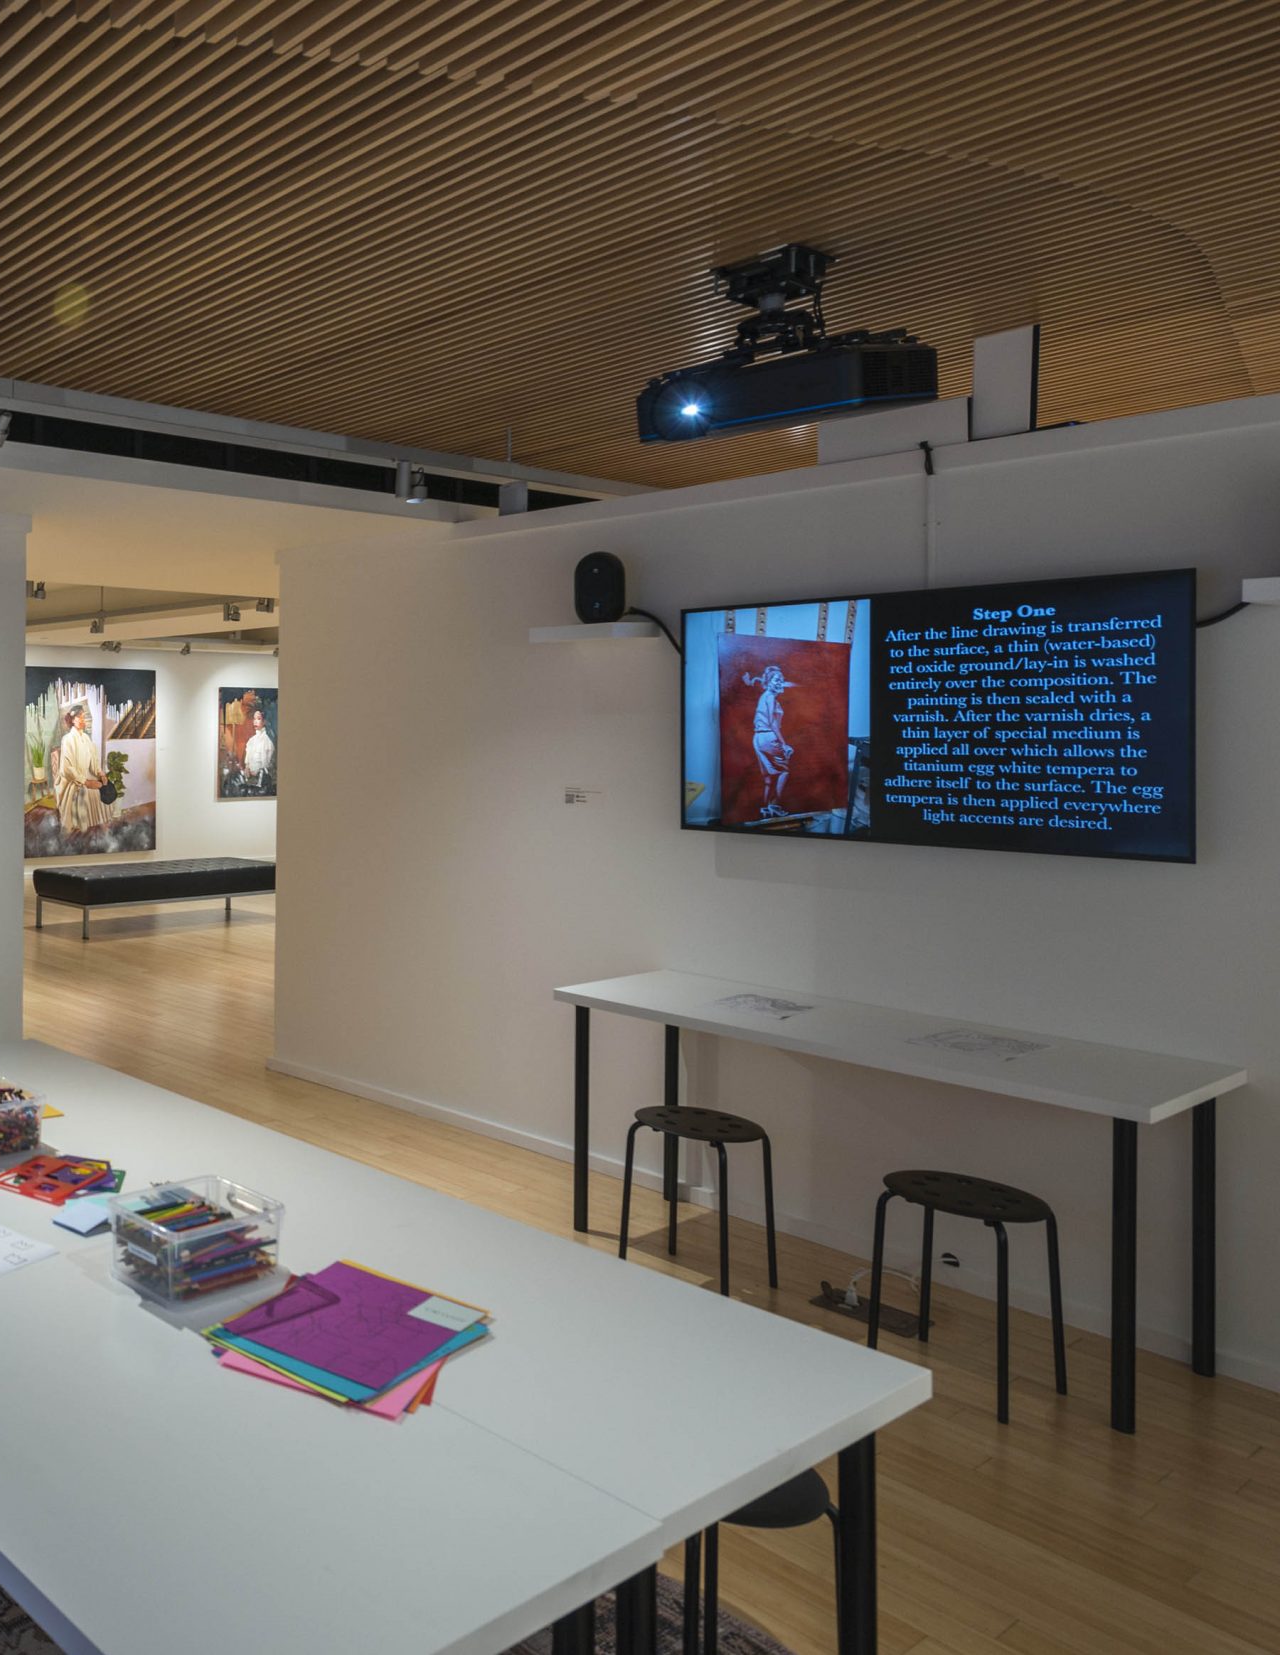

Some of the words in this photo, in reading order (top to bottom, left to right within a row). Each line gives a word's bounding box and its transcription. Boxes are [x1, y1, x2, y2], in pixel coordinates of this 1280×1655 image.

[973, 608, 1012, 622] Step
[1016, 605, 1056, 618] One
[885, 630, 921, 642] After
[924, 628, 947, 640] the
[951, 626, 978, 638] line
[982, 622, 1046, 638] drawing
[1051, 621, 1063, 633] is
[1068, 614, 1162, 632] transferred
[890, 649, 904, 658] to
[908, 645, 930, 657] the
[934, 643, 989, 656] surface,
[994, 645, 1003, 653] a
[1008, 640, 1039, 652] thin
[1044, 633, 1156, 654] (water-based)
[890, 662, 912, 674] red
[916, 660, 955, 673] oxide
[960, 656, 1068, 675] ground/lay-in
[1074, 655, 1086, 668] is
[1091, 652, 1156, 667] washed
[888, 678, 941, 692] entirely
[945, 680, 977, 688] over
[982, 676, 1005, 688] the
[1010, 673, 1114, 690] composition.
[1120, 671, 1156, 684] The
[908, 694, 967, 709] painting
[971, 693, 982, 705] is
[987, 692, 1020, 704] then
[1026, 691, 1075, 704] sealed
[1079, 690, 1116, 704] with
[1122, 694, 1132, 703] a
[893, 710, 948, 722] varnish.
[953, 710, 992, 722] After
[996, 710, 1020, 722] the
[1024, 708, 1084, 721] varnish
[1088, 708, 1135, 724] dries,
[1140, 712, 1152, 721] a
[902, 727, 929, 738] thin
[934, 727, 969, 742] layer
[973, 726, 990, 738] of
[995, 726, 1046, 742] special
[1052, 726, 1122, 739] medium
[1127, 726, 1140, 740] is
[896, 743, 948, 758] applied
[952, 744, 969, 755] all
[974, 748, 1007, 756] over
[1011, 744, 1058, 756] which
[1063, 744, 1115, 757] allows
[1120, 745, 1147, 758] the
[904, 760, 963, 772] titanium
[968, 764, 994, 776] egg
[999, 761, 1041, 774] white
[1046, 764, 1115, 778] tempera
[1120, 766, 1137, 776] to
[884, 775, 932, 787] adhere
[936, 777, 971, 789] itself
[976, 780, 991, 789] to
[996, 778, 1019, 790] the
[1024, 780, 1085, 792] surface.
[1091, 780, 1127, 794] The
[1132, 786, 1164, 799] egg
[886, 794, 943, 807] tempera
[948, 794, 958, 805] is
[963, 794, 995, 806] then
[1000, 796, 1058, 812] applied
[1064, 800, 1161, 815] everywhere
[924, 809, 954, 824] light
[960, 814, 1014, 824] accents
[1019, 817, 1044, 826] are
[1048, 815, 1112, 830] desired.
